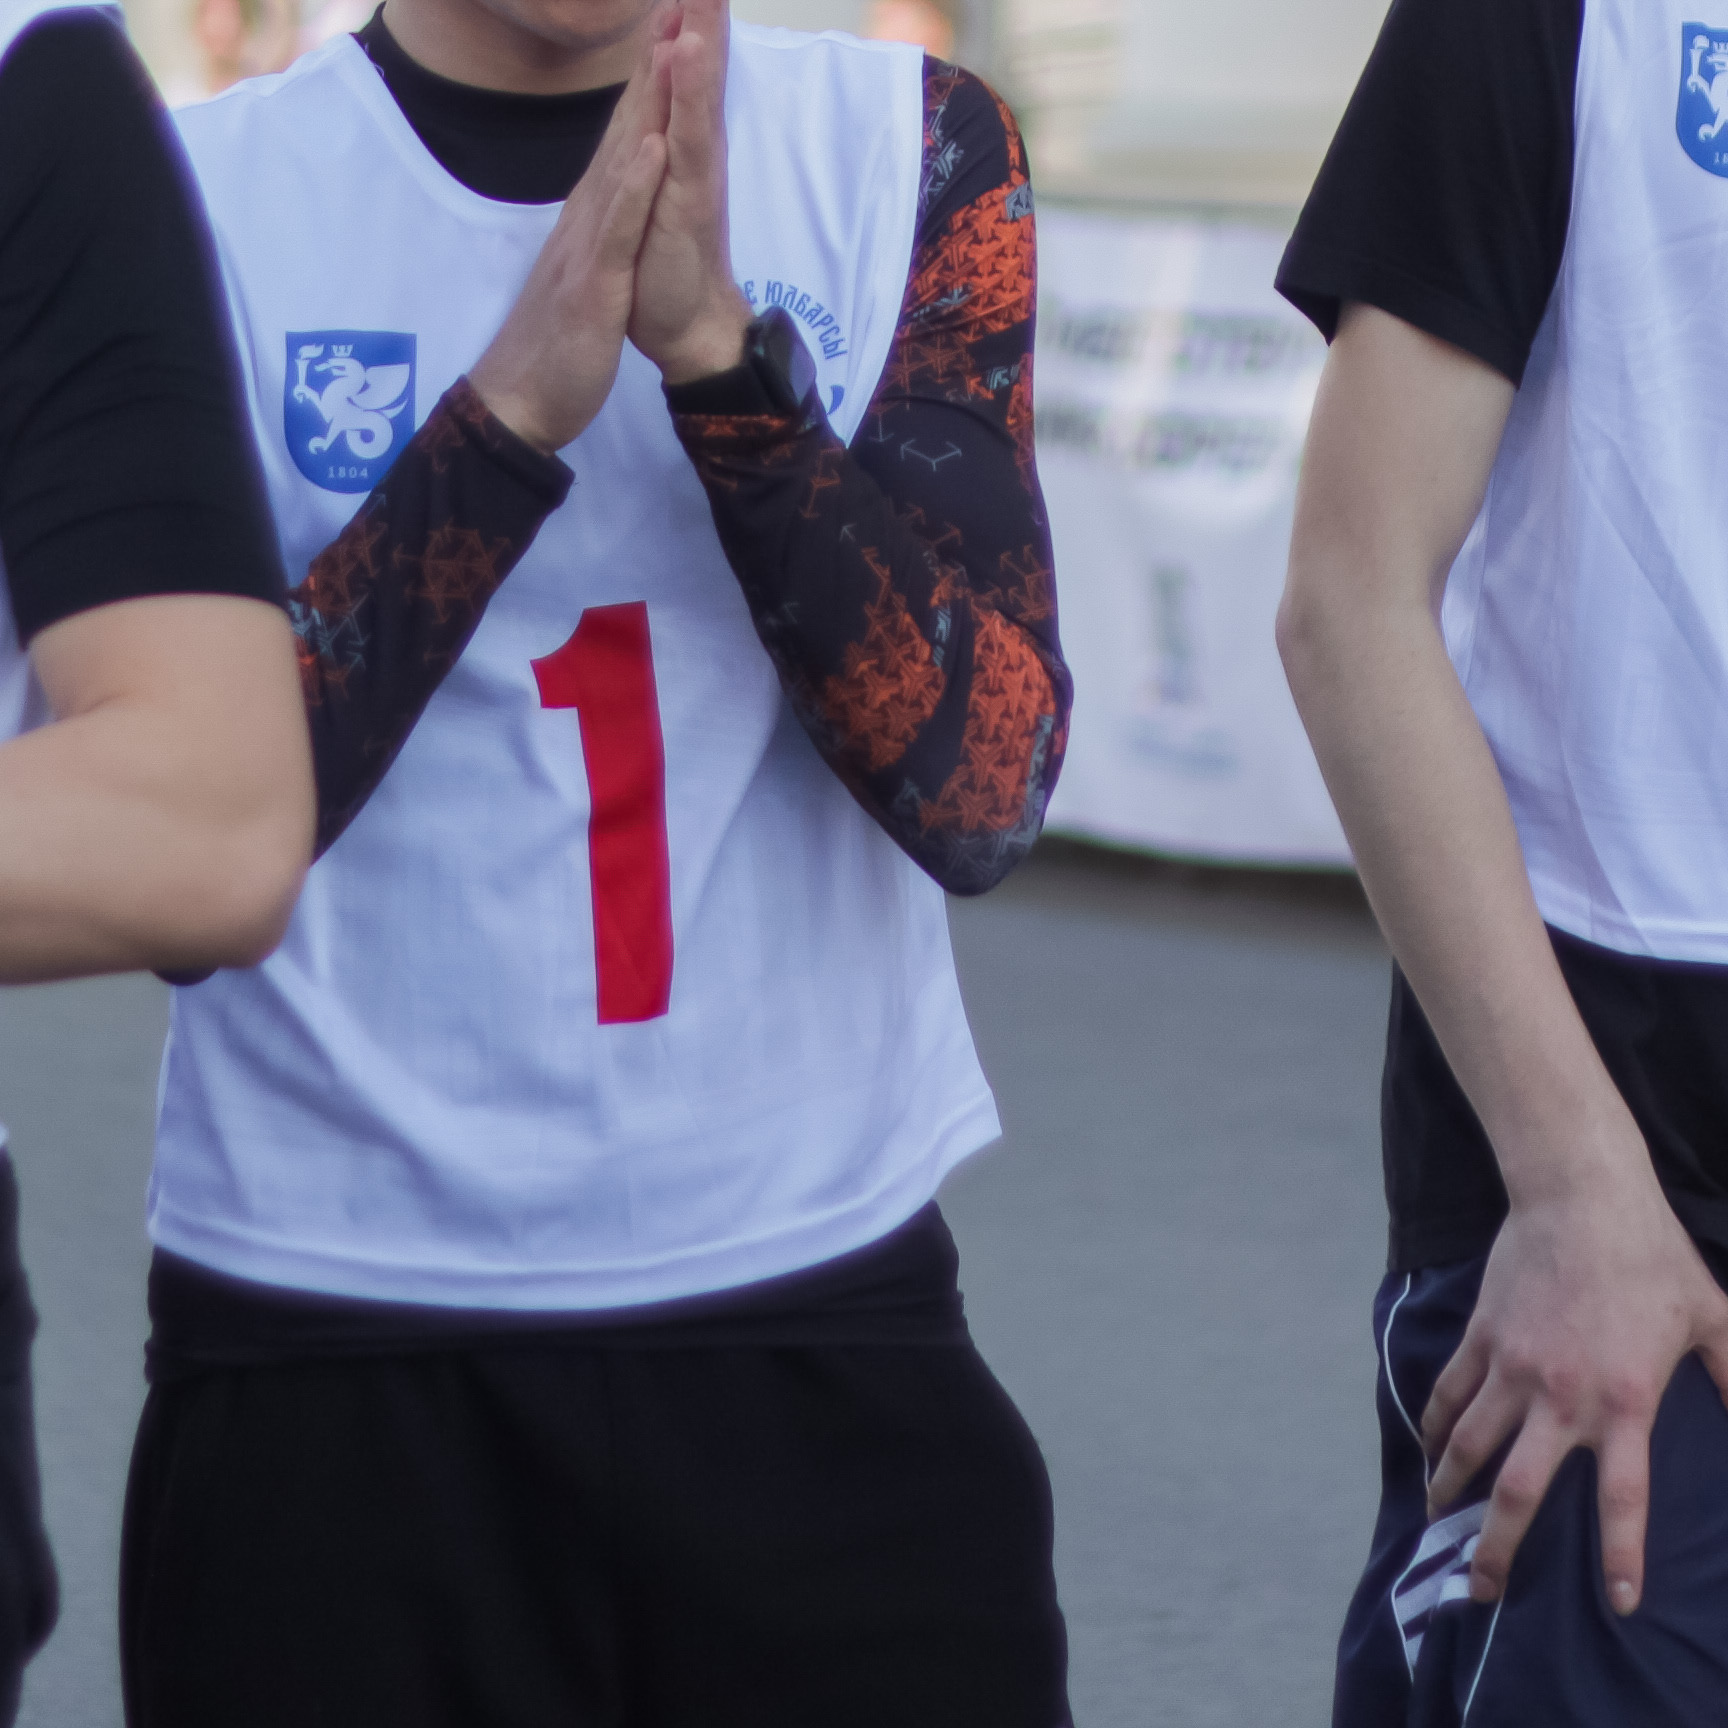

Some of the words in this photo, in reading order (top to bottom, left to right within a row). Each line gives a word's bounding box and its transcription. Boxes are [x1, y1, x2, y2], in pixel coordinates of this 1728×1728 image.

[765, 280, 848, 359] ЮЛБАРСЫ
[328, 466, 368, 478] 1804
[530, 600, 674, 1025] 1
